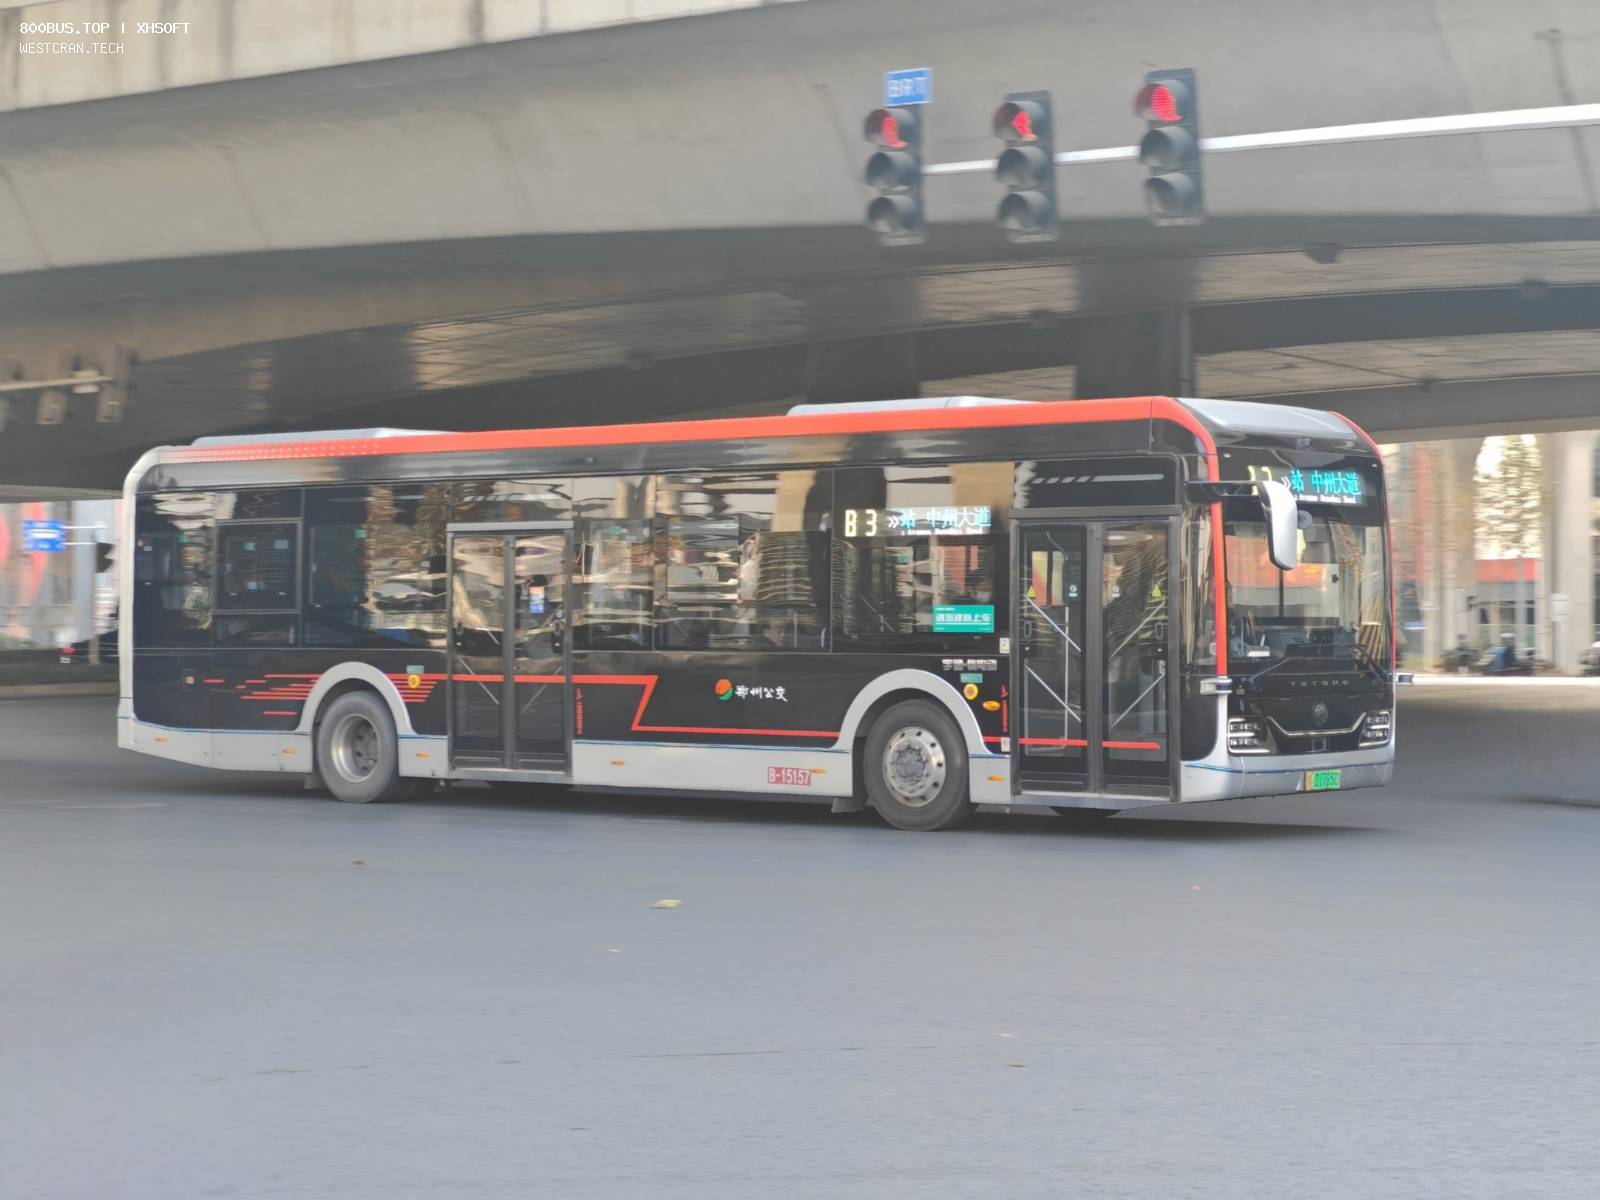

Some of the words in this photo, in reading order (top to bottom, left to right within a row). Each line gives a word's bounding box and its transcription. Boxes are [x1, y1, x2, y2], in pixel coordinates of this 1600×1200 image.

[888, 77, 928, 97] BRT
[1311, 470, 1361, 495] 中州大道
[926, 506, 992, 528] 中州大道
[735, 684, 788, 702] 郑州公交
[768, 767, 810, 785] B-15157
